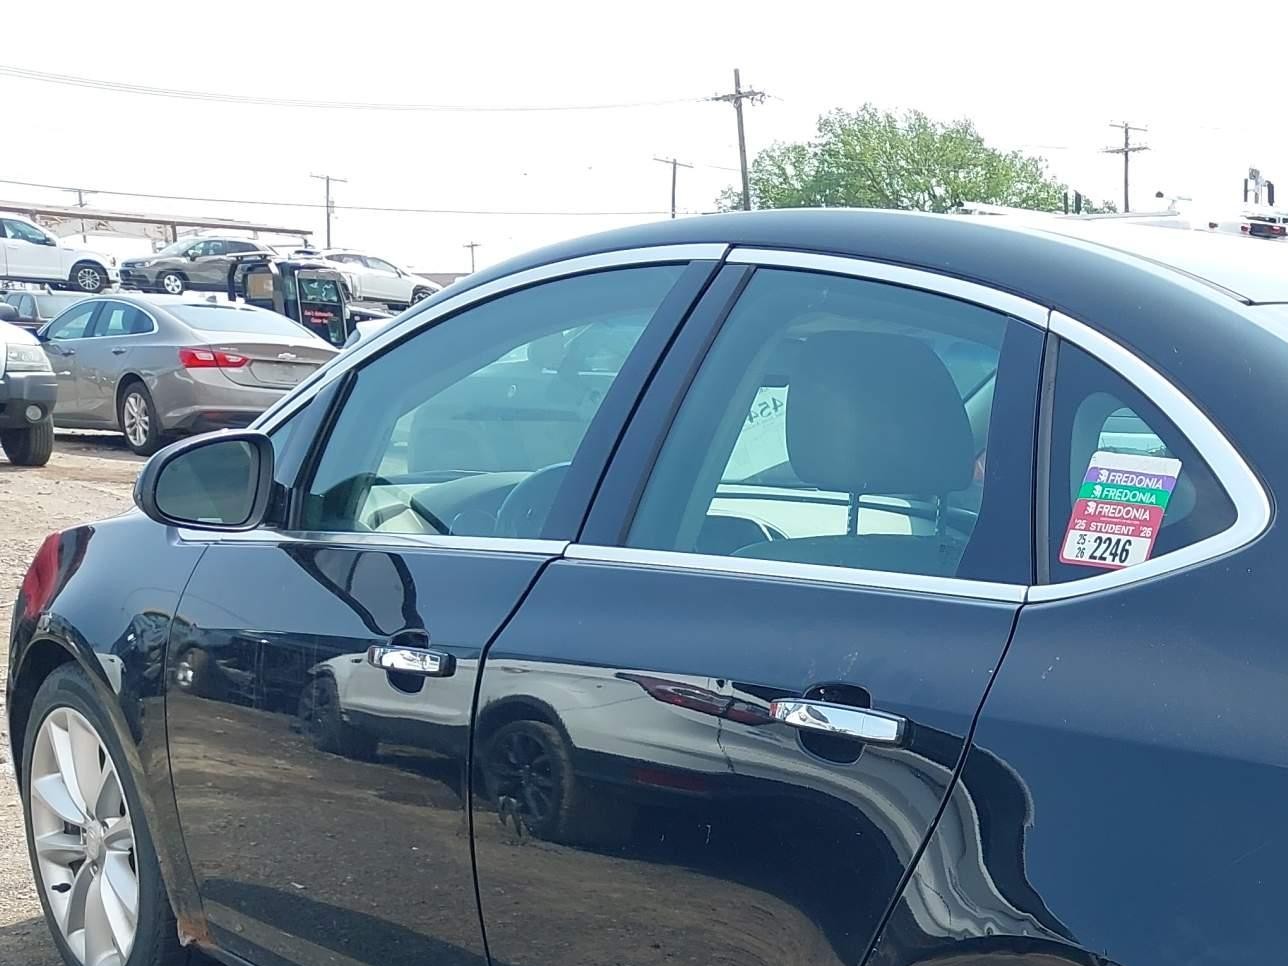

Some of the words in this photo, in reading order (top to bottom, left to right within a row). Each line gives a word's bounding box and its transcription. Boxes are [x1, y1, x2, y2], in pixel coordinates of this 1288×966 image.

[1108, 472, 1163, 489] FREDONIA
[1102, 487, 1156, 505] FREDONIA
[1096, 504, 1150, 521] FREDONIA
[1090, 522, 1135, 536] STUDENT
[1088, 536, 1132, 564] 2246
